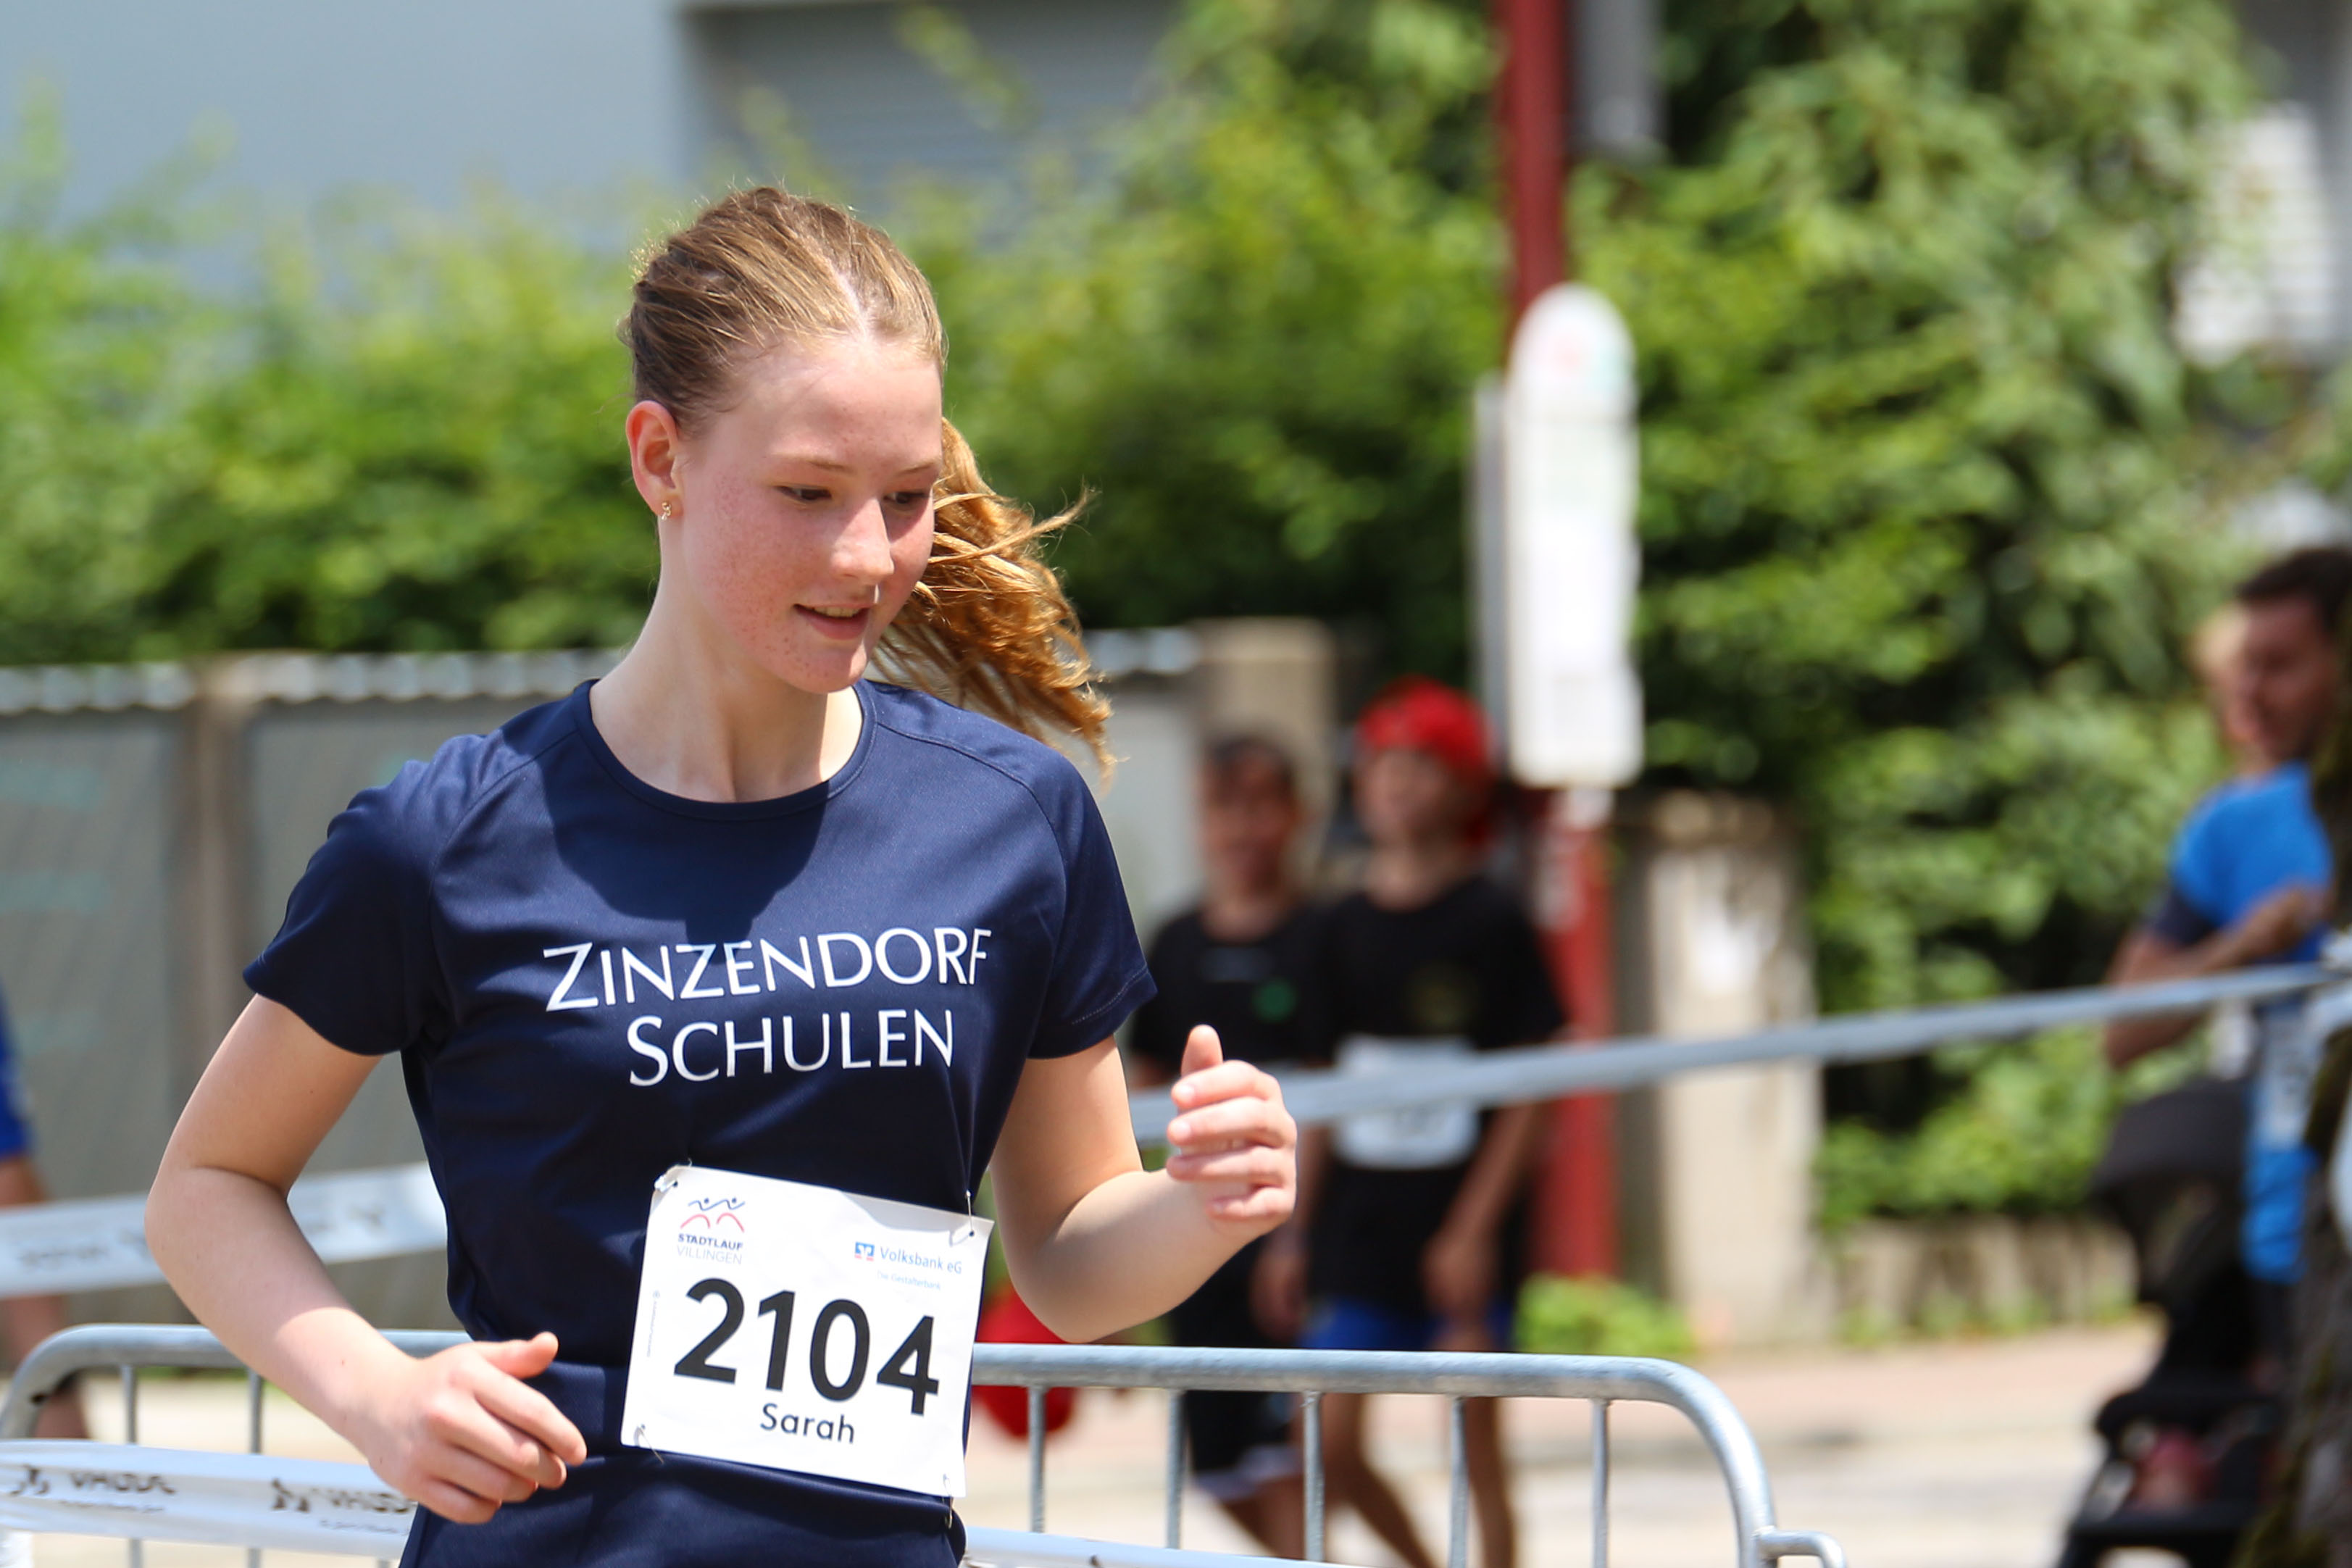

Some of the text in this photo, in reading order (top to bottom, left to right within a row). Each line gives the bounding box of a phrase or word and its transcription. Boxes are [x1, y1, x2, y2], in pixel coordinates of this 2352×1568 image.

[543, 927, 991, 1011] ZINZENDORF
[627, 1009, 953, 1085] SCHULEN
[677, 1244, 743, 1264] VILLINGEN
[678, 1233, 743, 1251] STADTLAUF
[880, 1246, 962, 1275] Volksbank eG
[673, 1277, 939, 1416] 2104
[760, 1403, 855, 1443] Sarah
